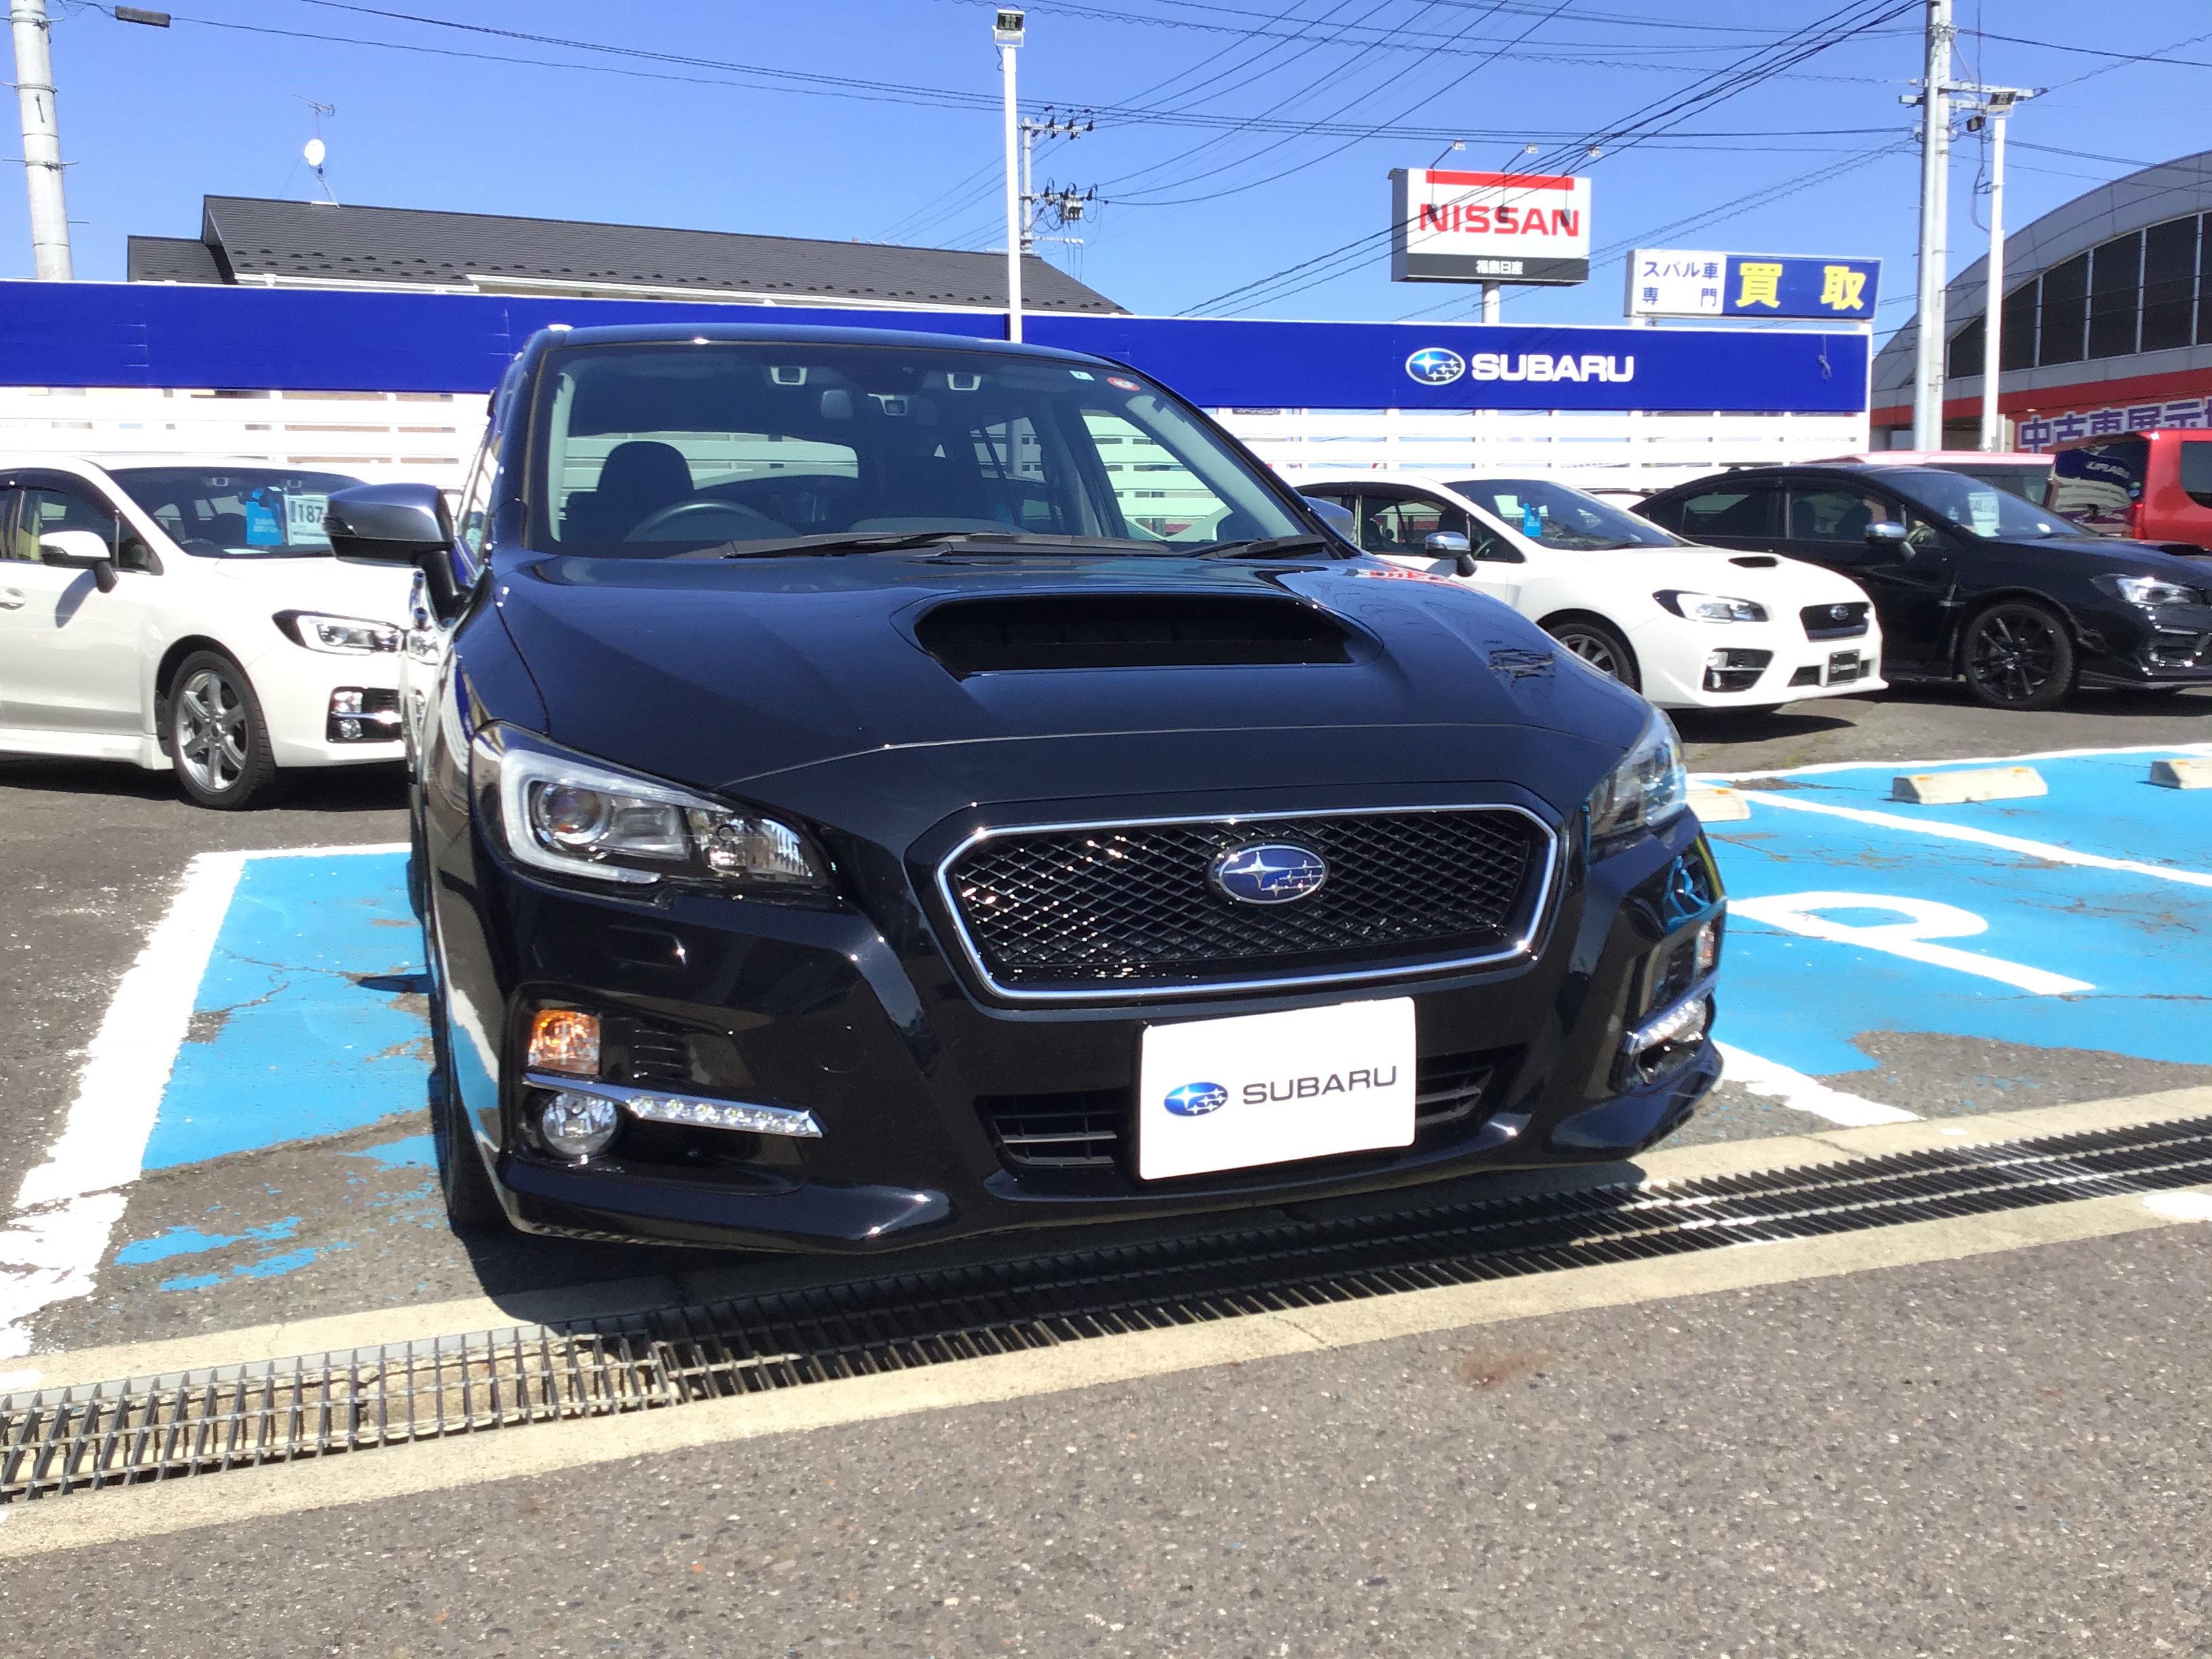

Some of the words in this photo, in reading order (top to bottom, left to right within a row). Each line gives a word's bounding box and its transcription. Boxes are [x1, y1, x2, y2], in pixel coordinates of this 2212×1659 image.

[1420, 203, 1579, 237] NISSAN
[1643, 261, 1719, 279] スバル車
[1735, 262, 1866, 310] 買取
[1642, 287, 1718, 307] 専門
[1471, 354, 1634, 382] SUBARU
[2020, 397, 2212, 453] 中古車展示
[1242, 1065, 1397, 1105] SUBARU
